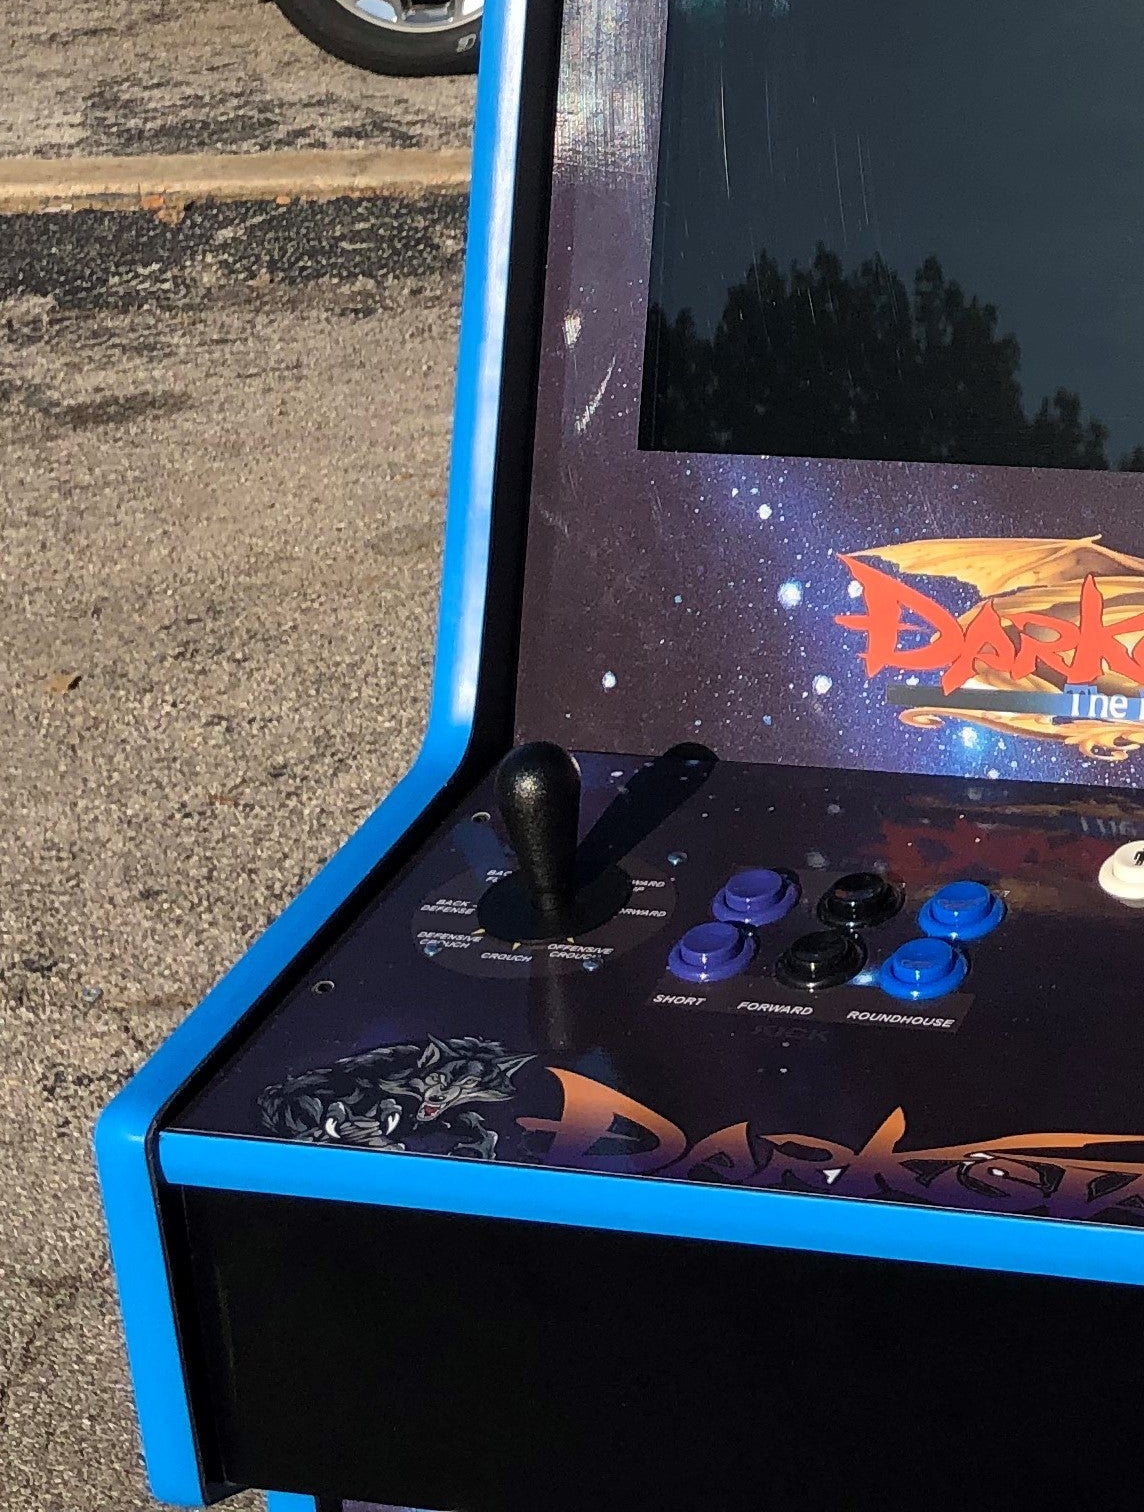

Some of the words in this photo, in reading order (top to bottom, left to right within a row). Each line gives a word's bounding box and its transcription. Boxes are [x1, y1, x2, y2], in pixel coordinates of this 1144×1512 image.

[1066, 688, 1128, 721] The
[436, 899, 471, 907] BACK
[420, 904, 476, 915] DEFENSE
[416, 931, 484, 943] DEFENSIVE
[547, 943, 614, 955] OFFENSIVE
[480, 952, 532, 963] CROUCH
[653, 994, 706, 1006] SHORT
[737, 1001, 813, 1016] FORWARD
[846, 1010, 955, 1028] ROUNDHOUSE
